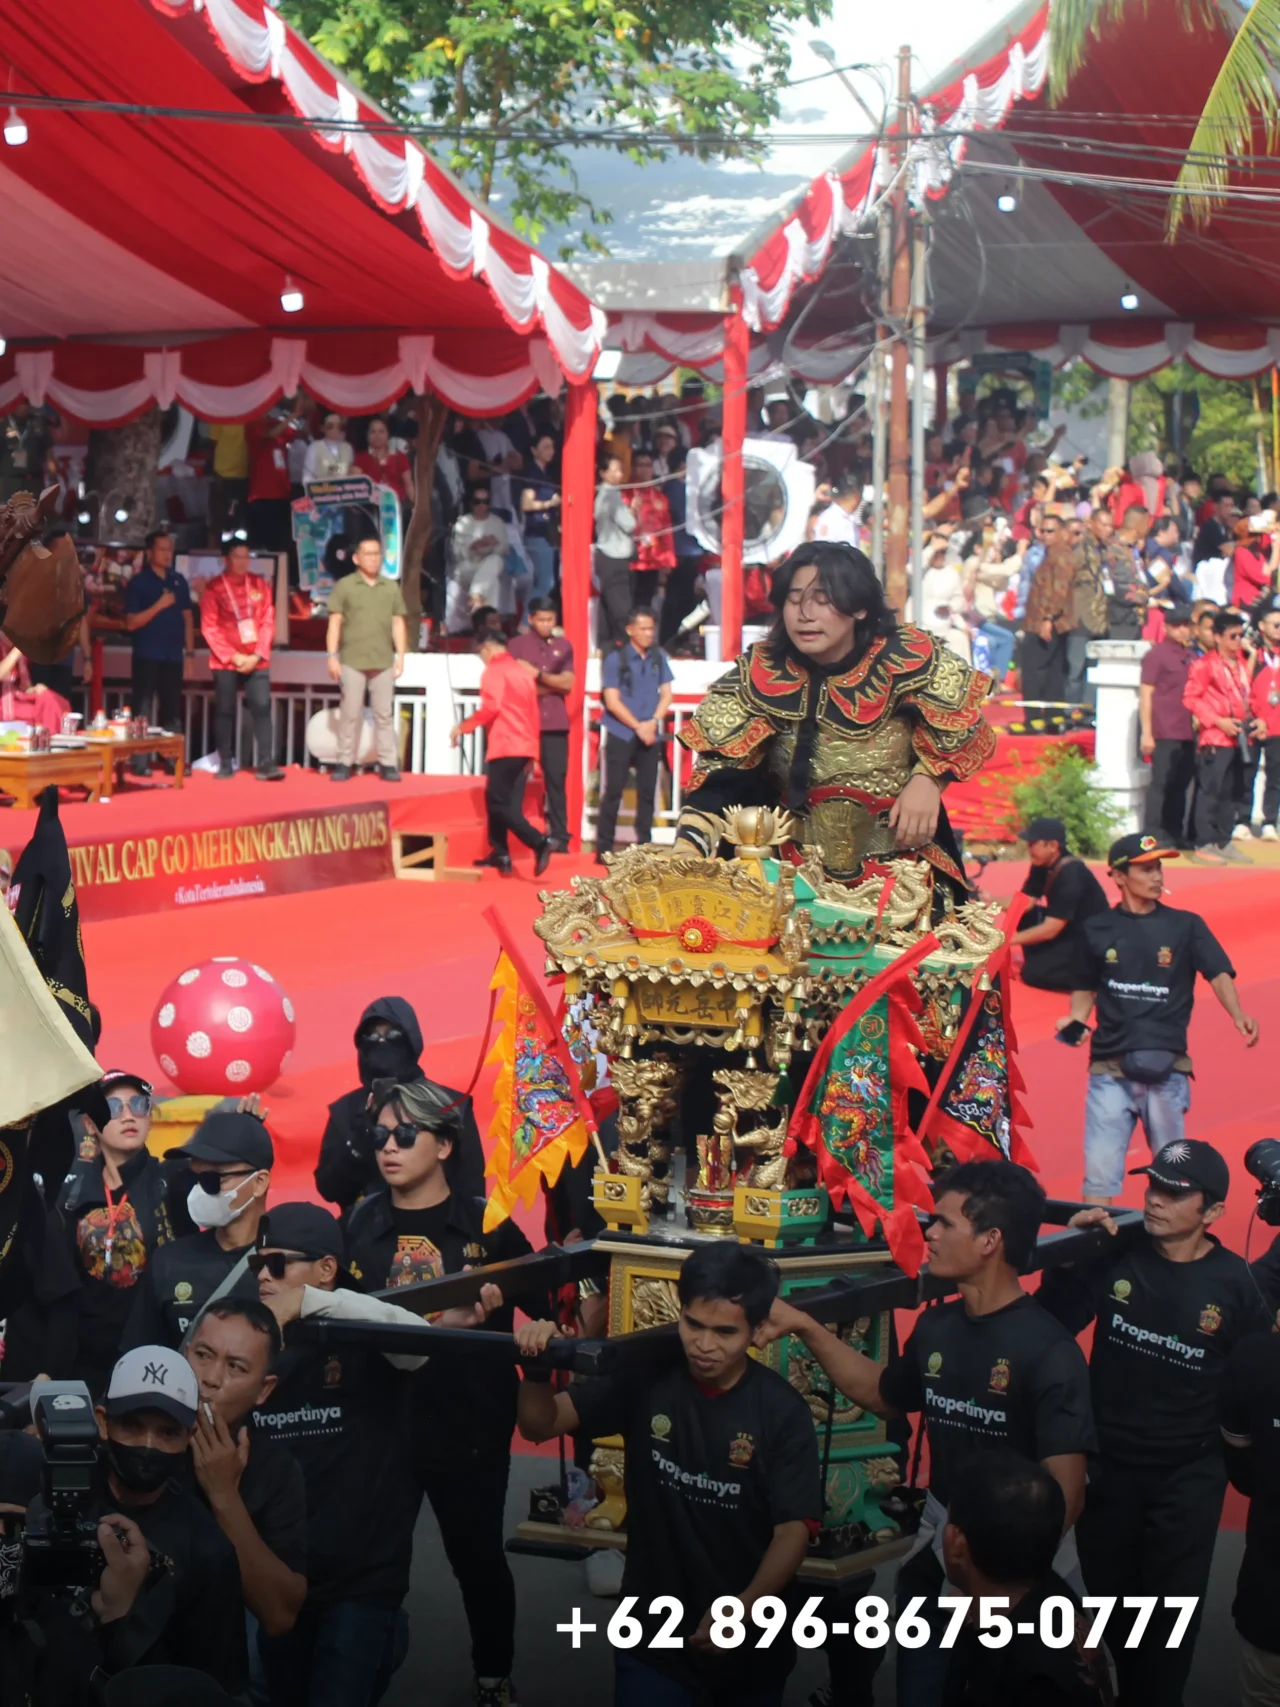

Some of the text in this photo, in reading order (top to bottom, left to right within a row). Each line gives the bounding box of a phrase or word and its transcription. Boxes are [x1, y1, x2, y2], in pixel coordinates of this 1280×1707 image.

[122, 836, 160, 881] CAP
[161, 832, 190, 874] GO
[192, 828, 233, 872] MEH
[234, 813, 351, 865] SINGKAWANG
[352, 811, 387, 849] 2025
[1112, 1313, 1206, 1359] Propertinya
[252, 1402, 342, 1429] Propertinya
